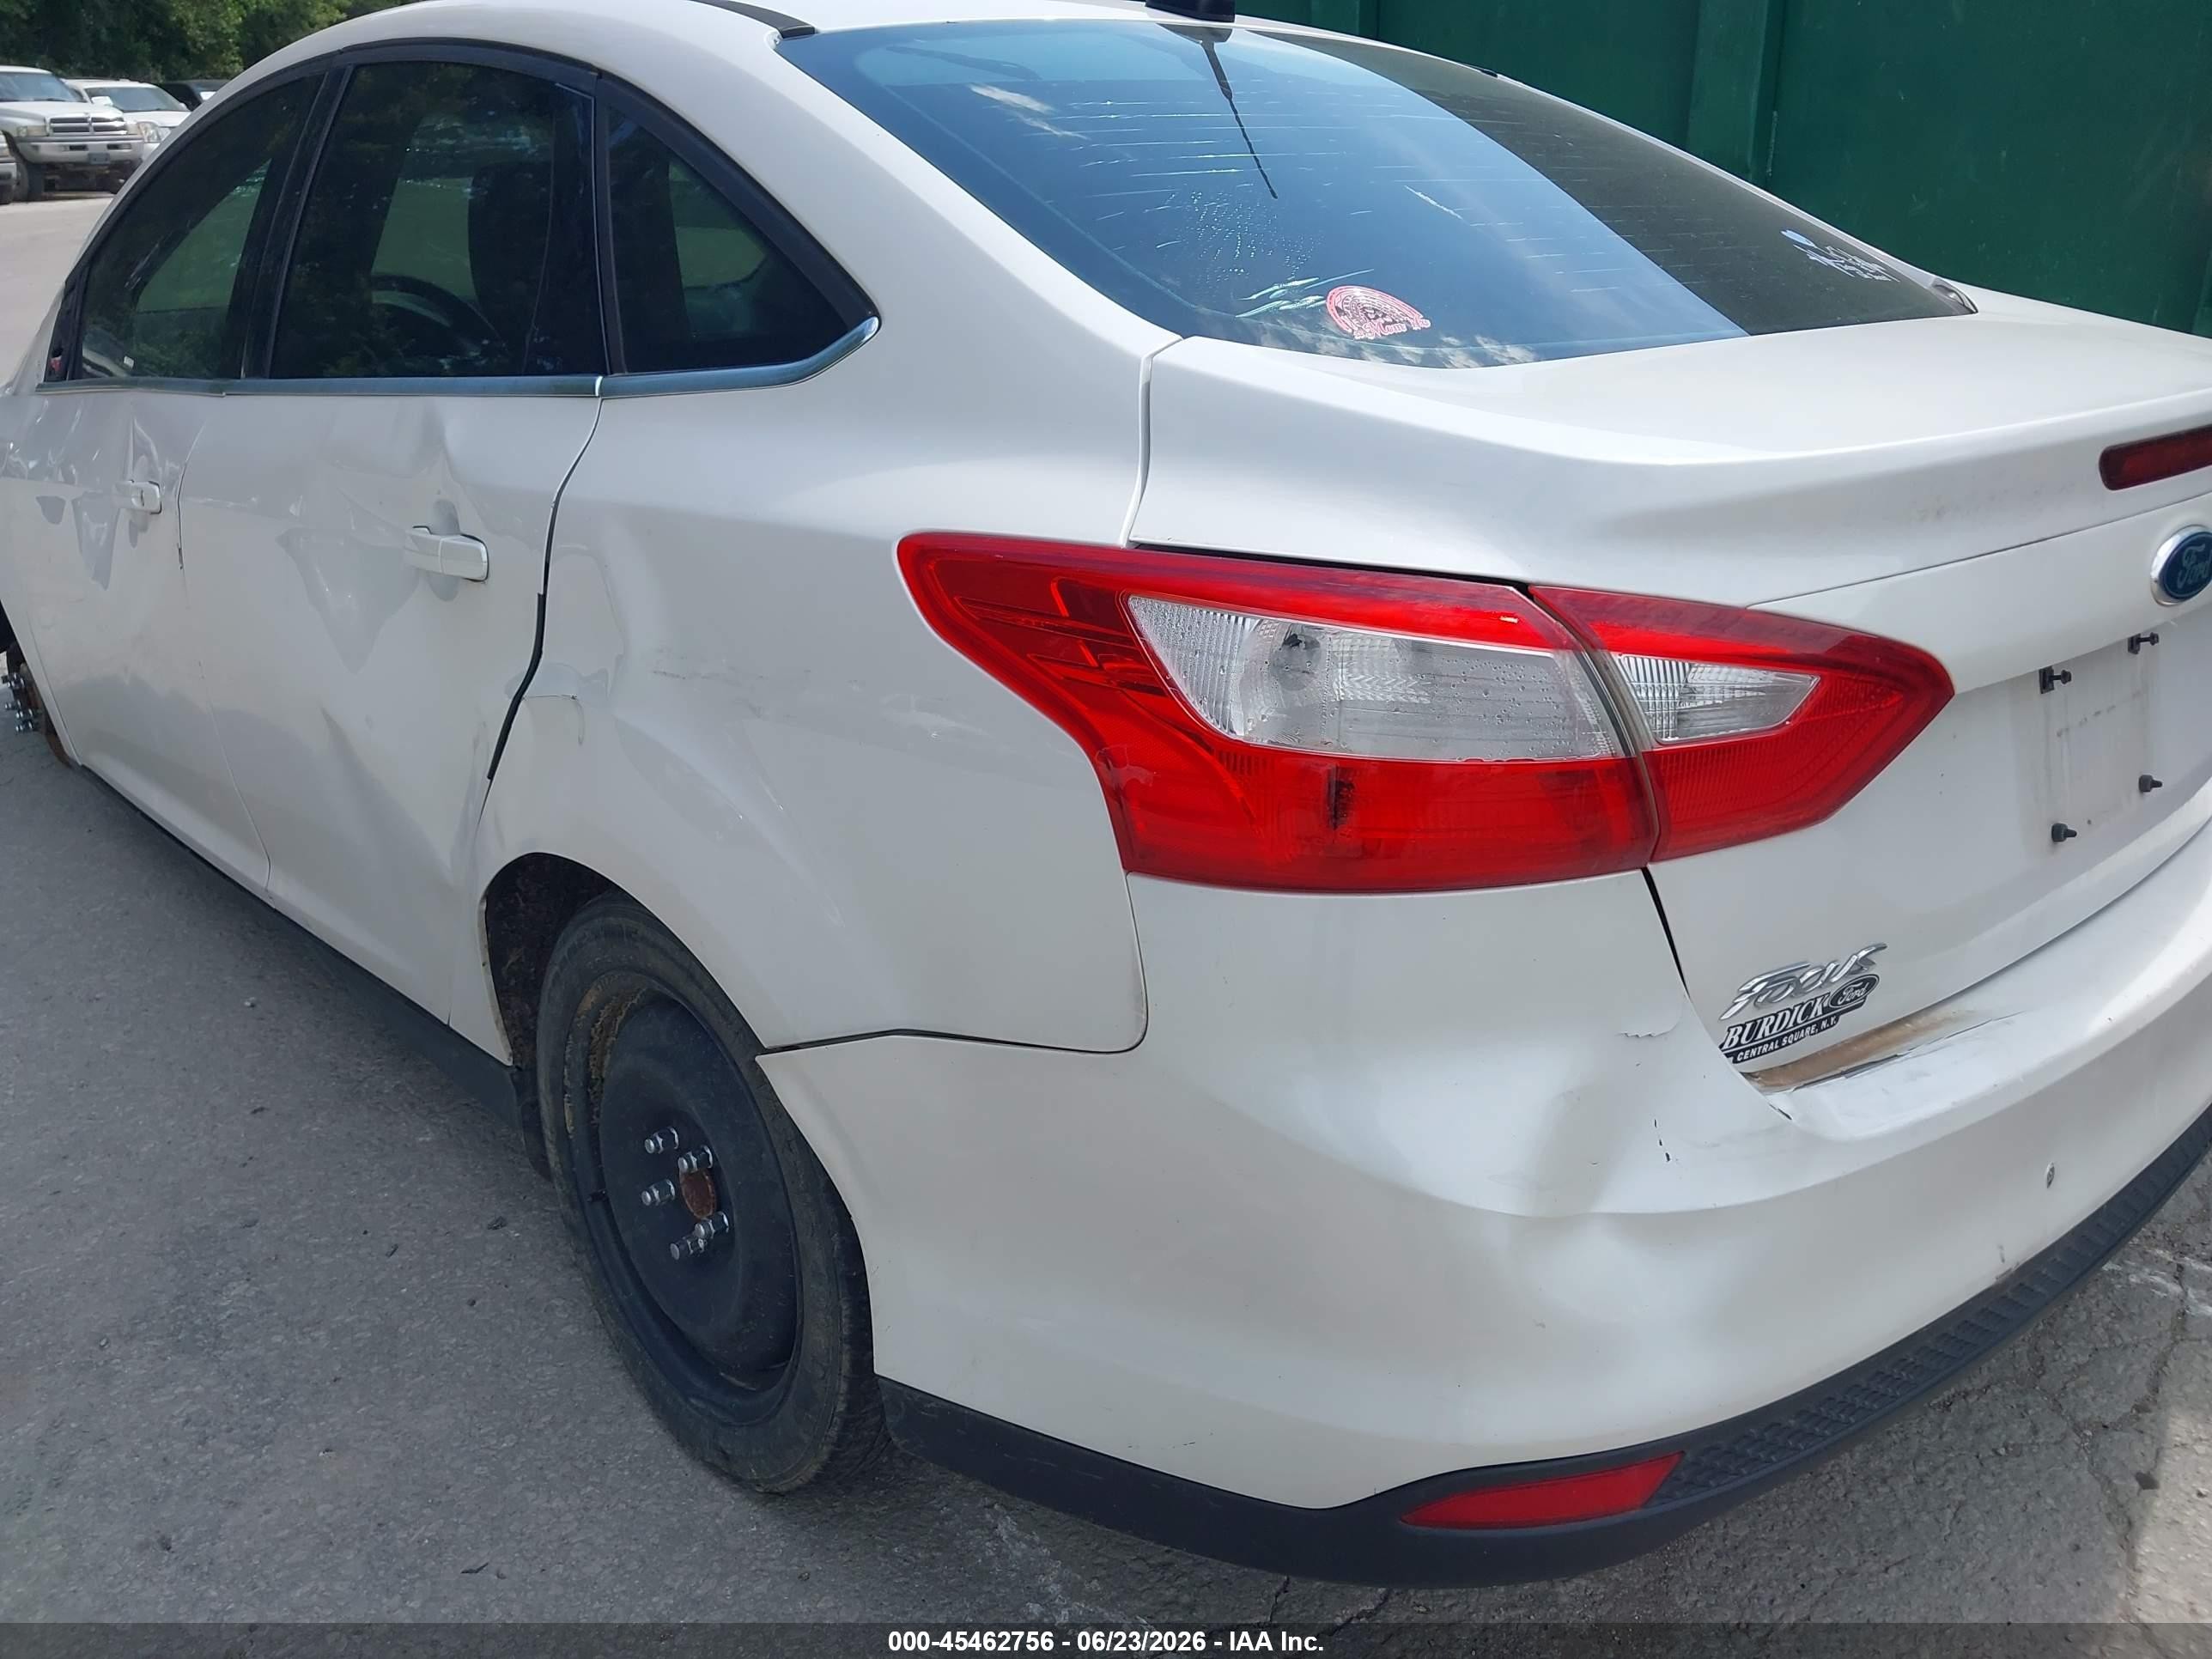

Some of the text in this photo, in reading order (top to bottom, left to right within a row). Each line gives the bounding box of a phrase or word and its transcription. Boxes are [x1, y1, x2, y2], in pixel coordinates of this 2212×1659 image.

[1719, 943, 1887, 1021] Focus
[1838, 981, 1870, 1006] Ford
[1721, 994, 1831, 1049] BURDICK
[1736, 1015, 1838, 1062] CENTRAL SQUARE, N.Y.
